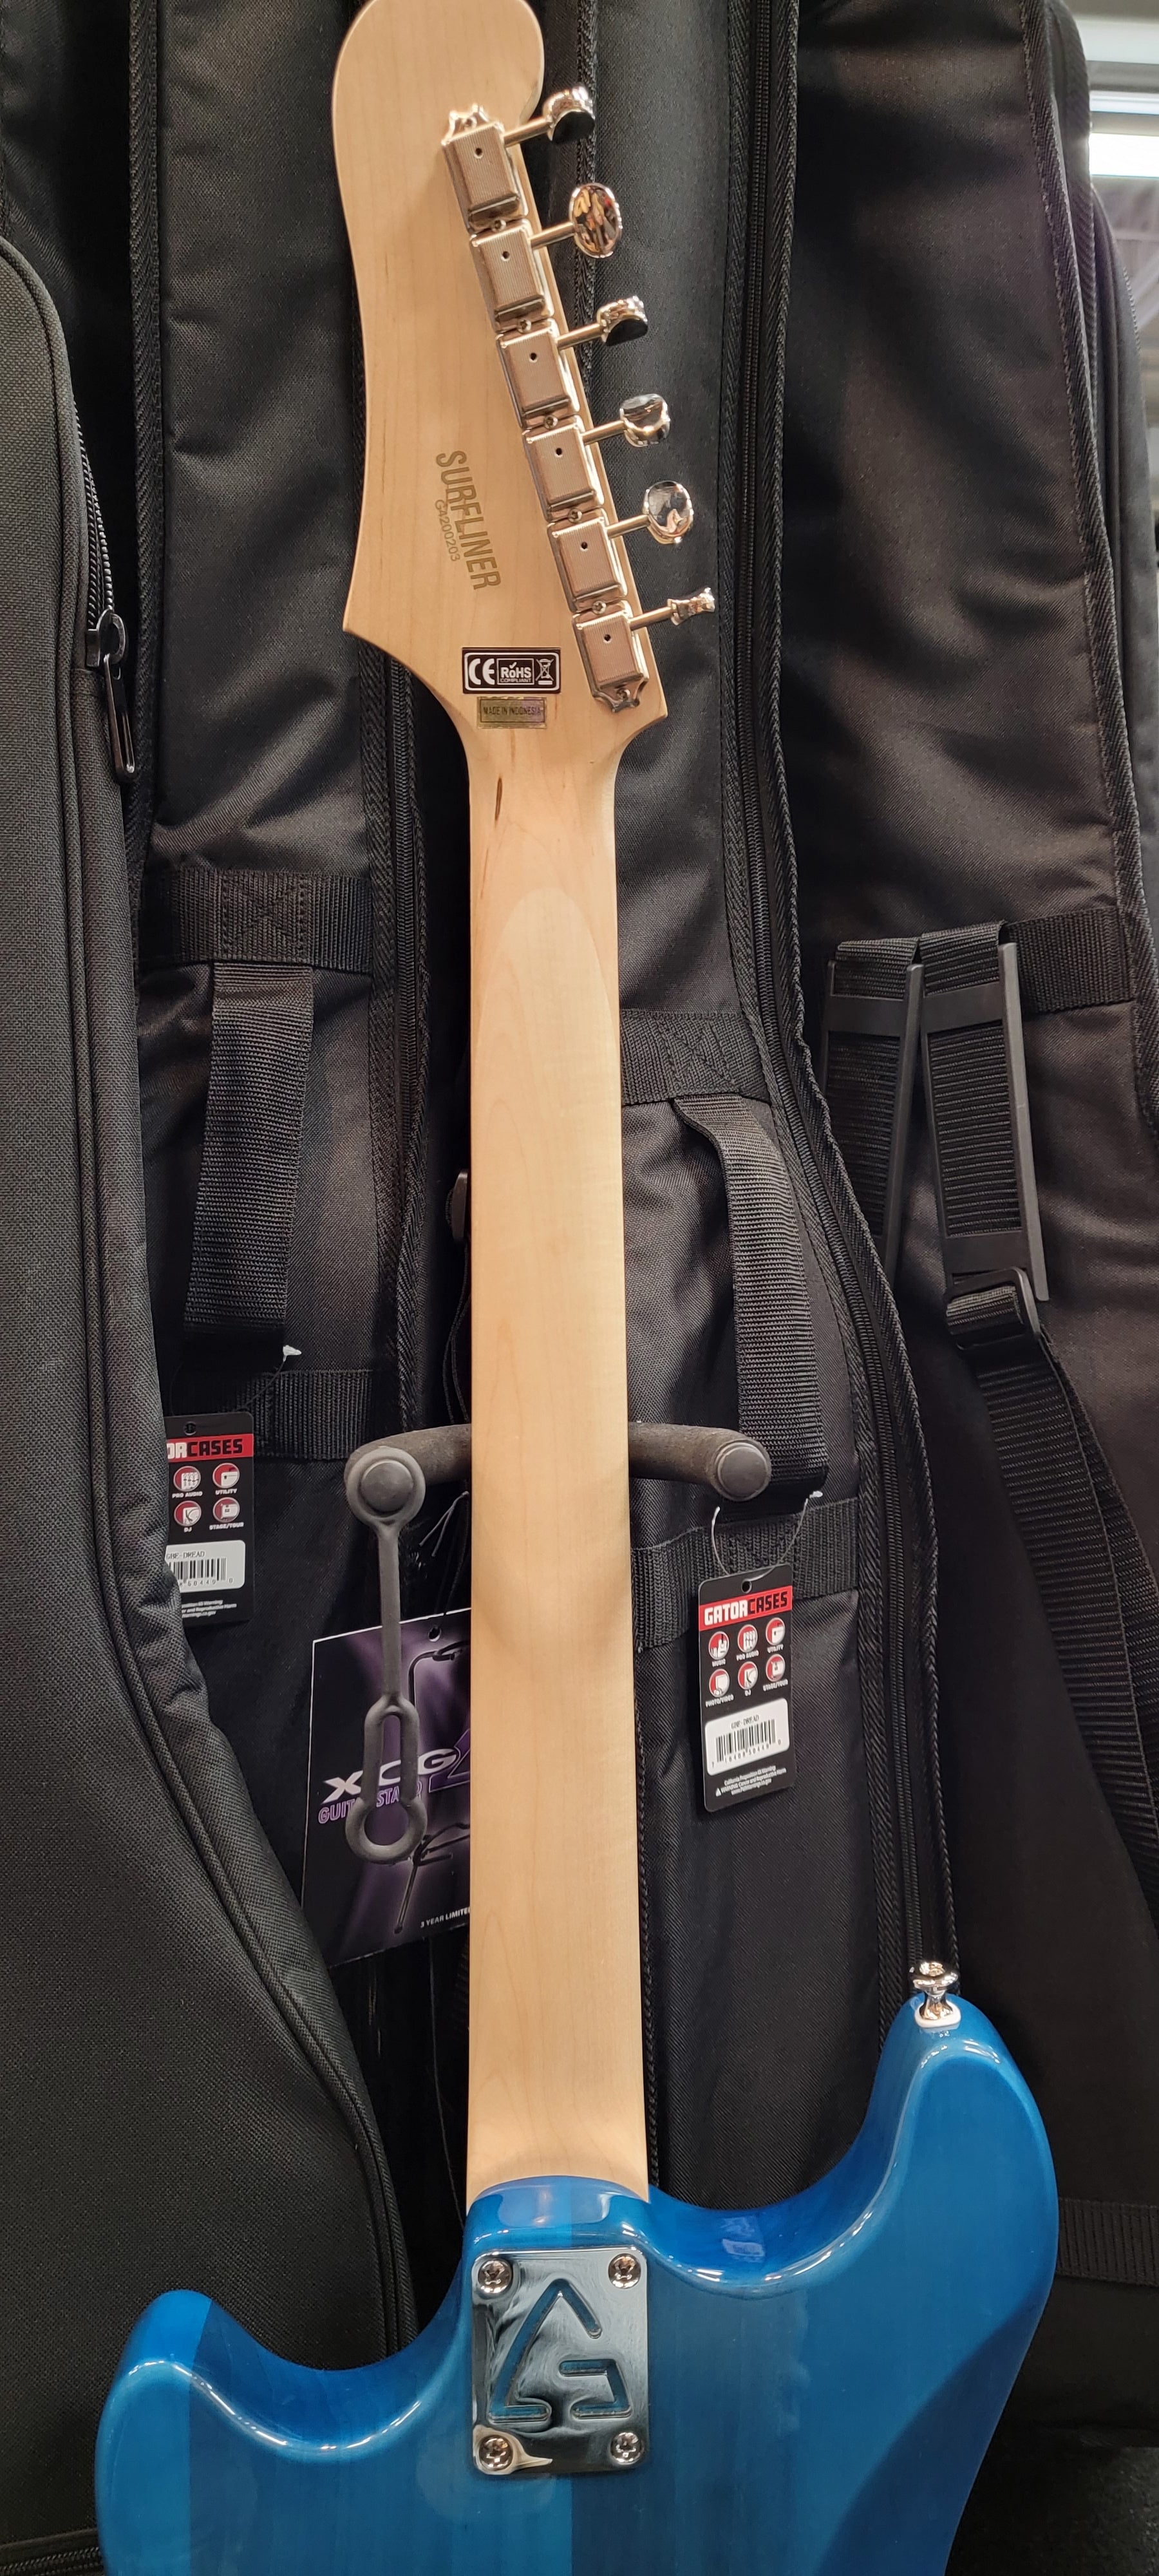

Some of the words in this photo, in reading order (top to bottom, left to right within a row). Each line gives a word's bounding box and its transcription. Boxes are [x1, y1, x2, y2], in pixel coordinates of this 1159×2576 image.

[436, 451, 501, 590] SURFLINER
[469, 658, 495, 685] CE
[500, 667, 532, 678] RoHS
[483, 706, 500, 715] MADE
[501, 706, 507, 715] IN
[509, 706, 542, 715] INDONESIA
[166, 1439, 243, 1459] ORCASES
[704, 1591, 787, 1626] GATORCASES
[746, 1650, 759, 1658] AUDIO
[712, 1658, 726, 1667] MUSIC
[318, 1799, 355, 1824] GUIT
[426, 1915, 444, 1926] YEAR
